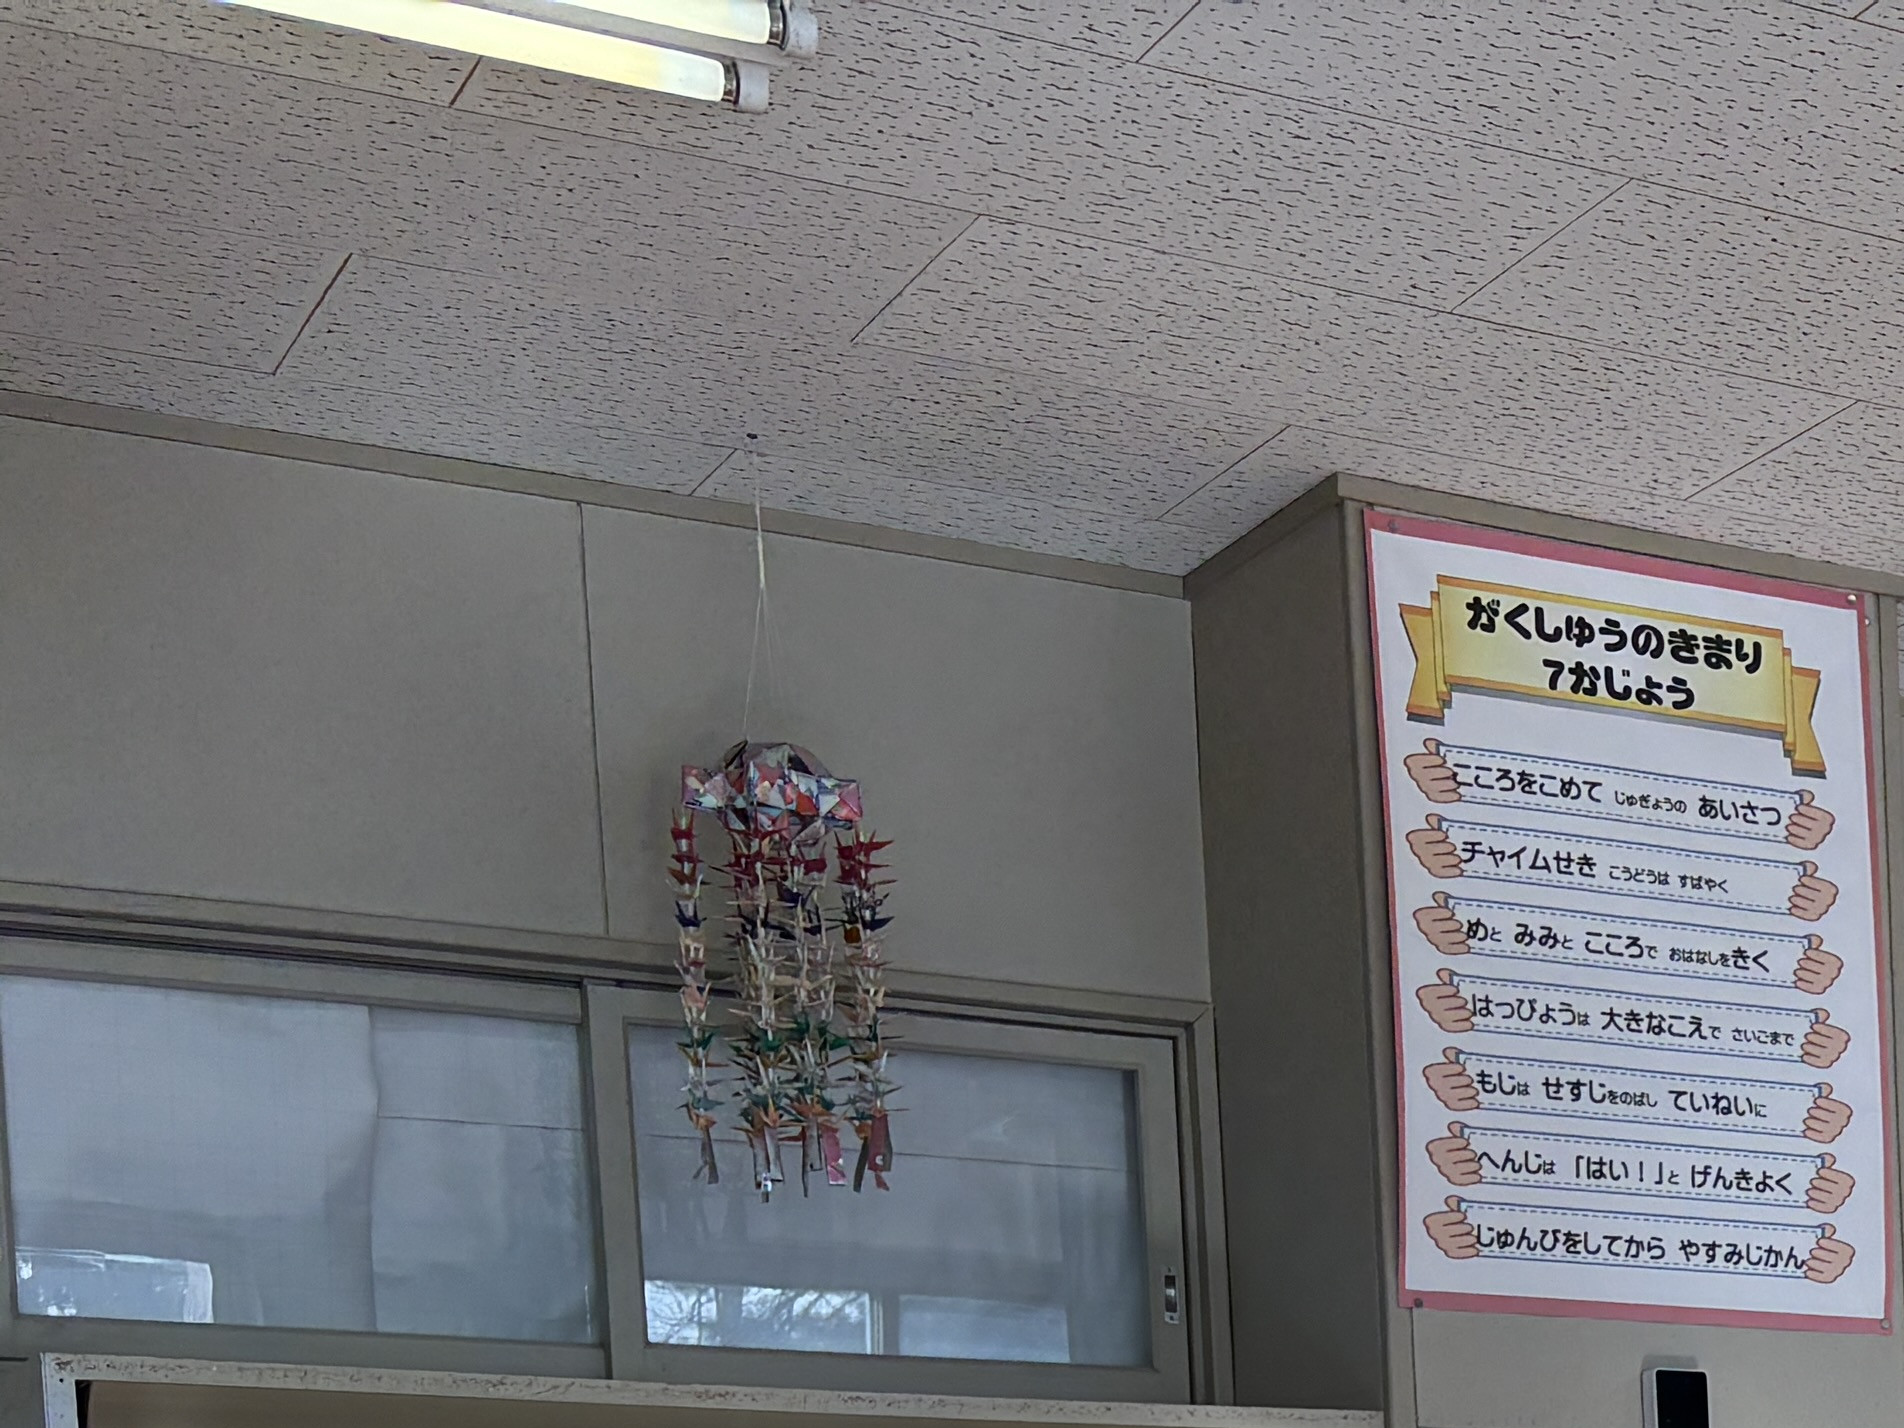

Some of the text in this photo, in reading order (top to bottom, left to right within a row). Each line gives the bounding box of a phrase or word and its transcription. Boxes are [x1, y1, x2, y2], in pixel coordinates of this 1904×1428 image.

[1465, 597, 1763, 673] がくしゅうのきまり
[1542, 658, 1696, 710] 7かじょう
[1452, 763, 1783, 826] こころをこめて じゅぎょうの あいさつ
[1460, 840, 1729, 894] チャイムせき こうどうは すばやく
[1466, 918, 1503, 944] めと
[1514, 923, 1574, 950] みみと
[1584, 931, 1658, 961] こころで
[1471, 994, 1796, 1048] はっぴょうは 大きなこえで さいごまで
[1476, 1072, 1530, 1098] もじは
[1669, 1089, 1768, 1118] ていねいに
[1478, 1149, 1556, 1176] へんじは
[1690, 1165, 1793, 1196] げんきよく
[1475, 1225, 1804, 1271] じゅんびをしてから やすみじかん
